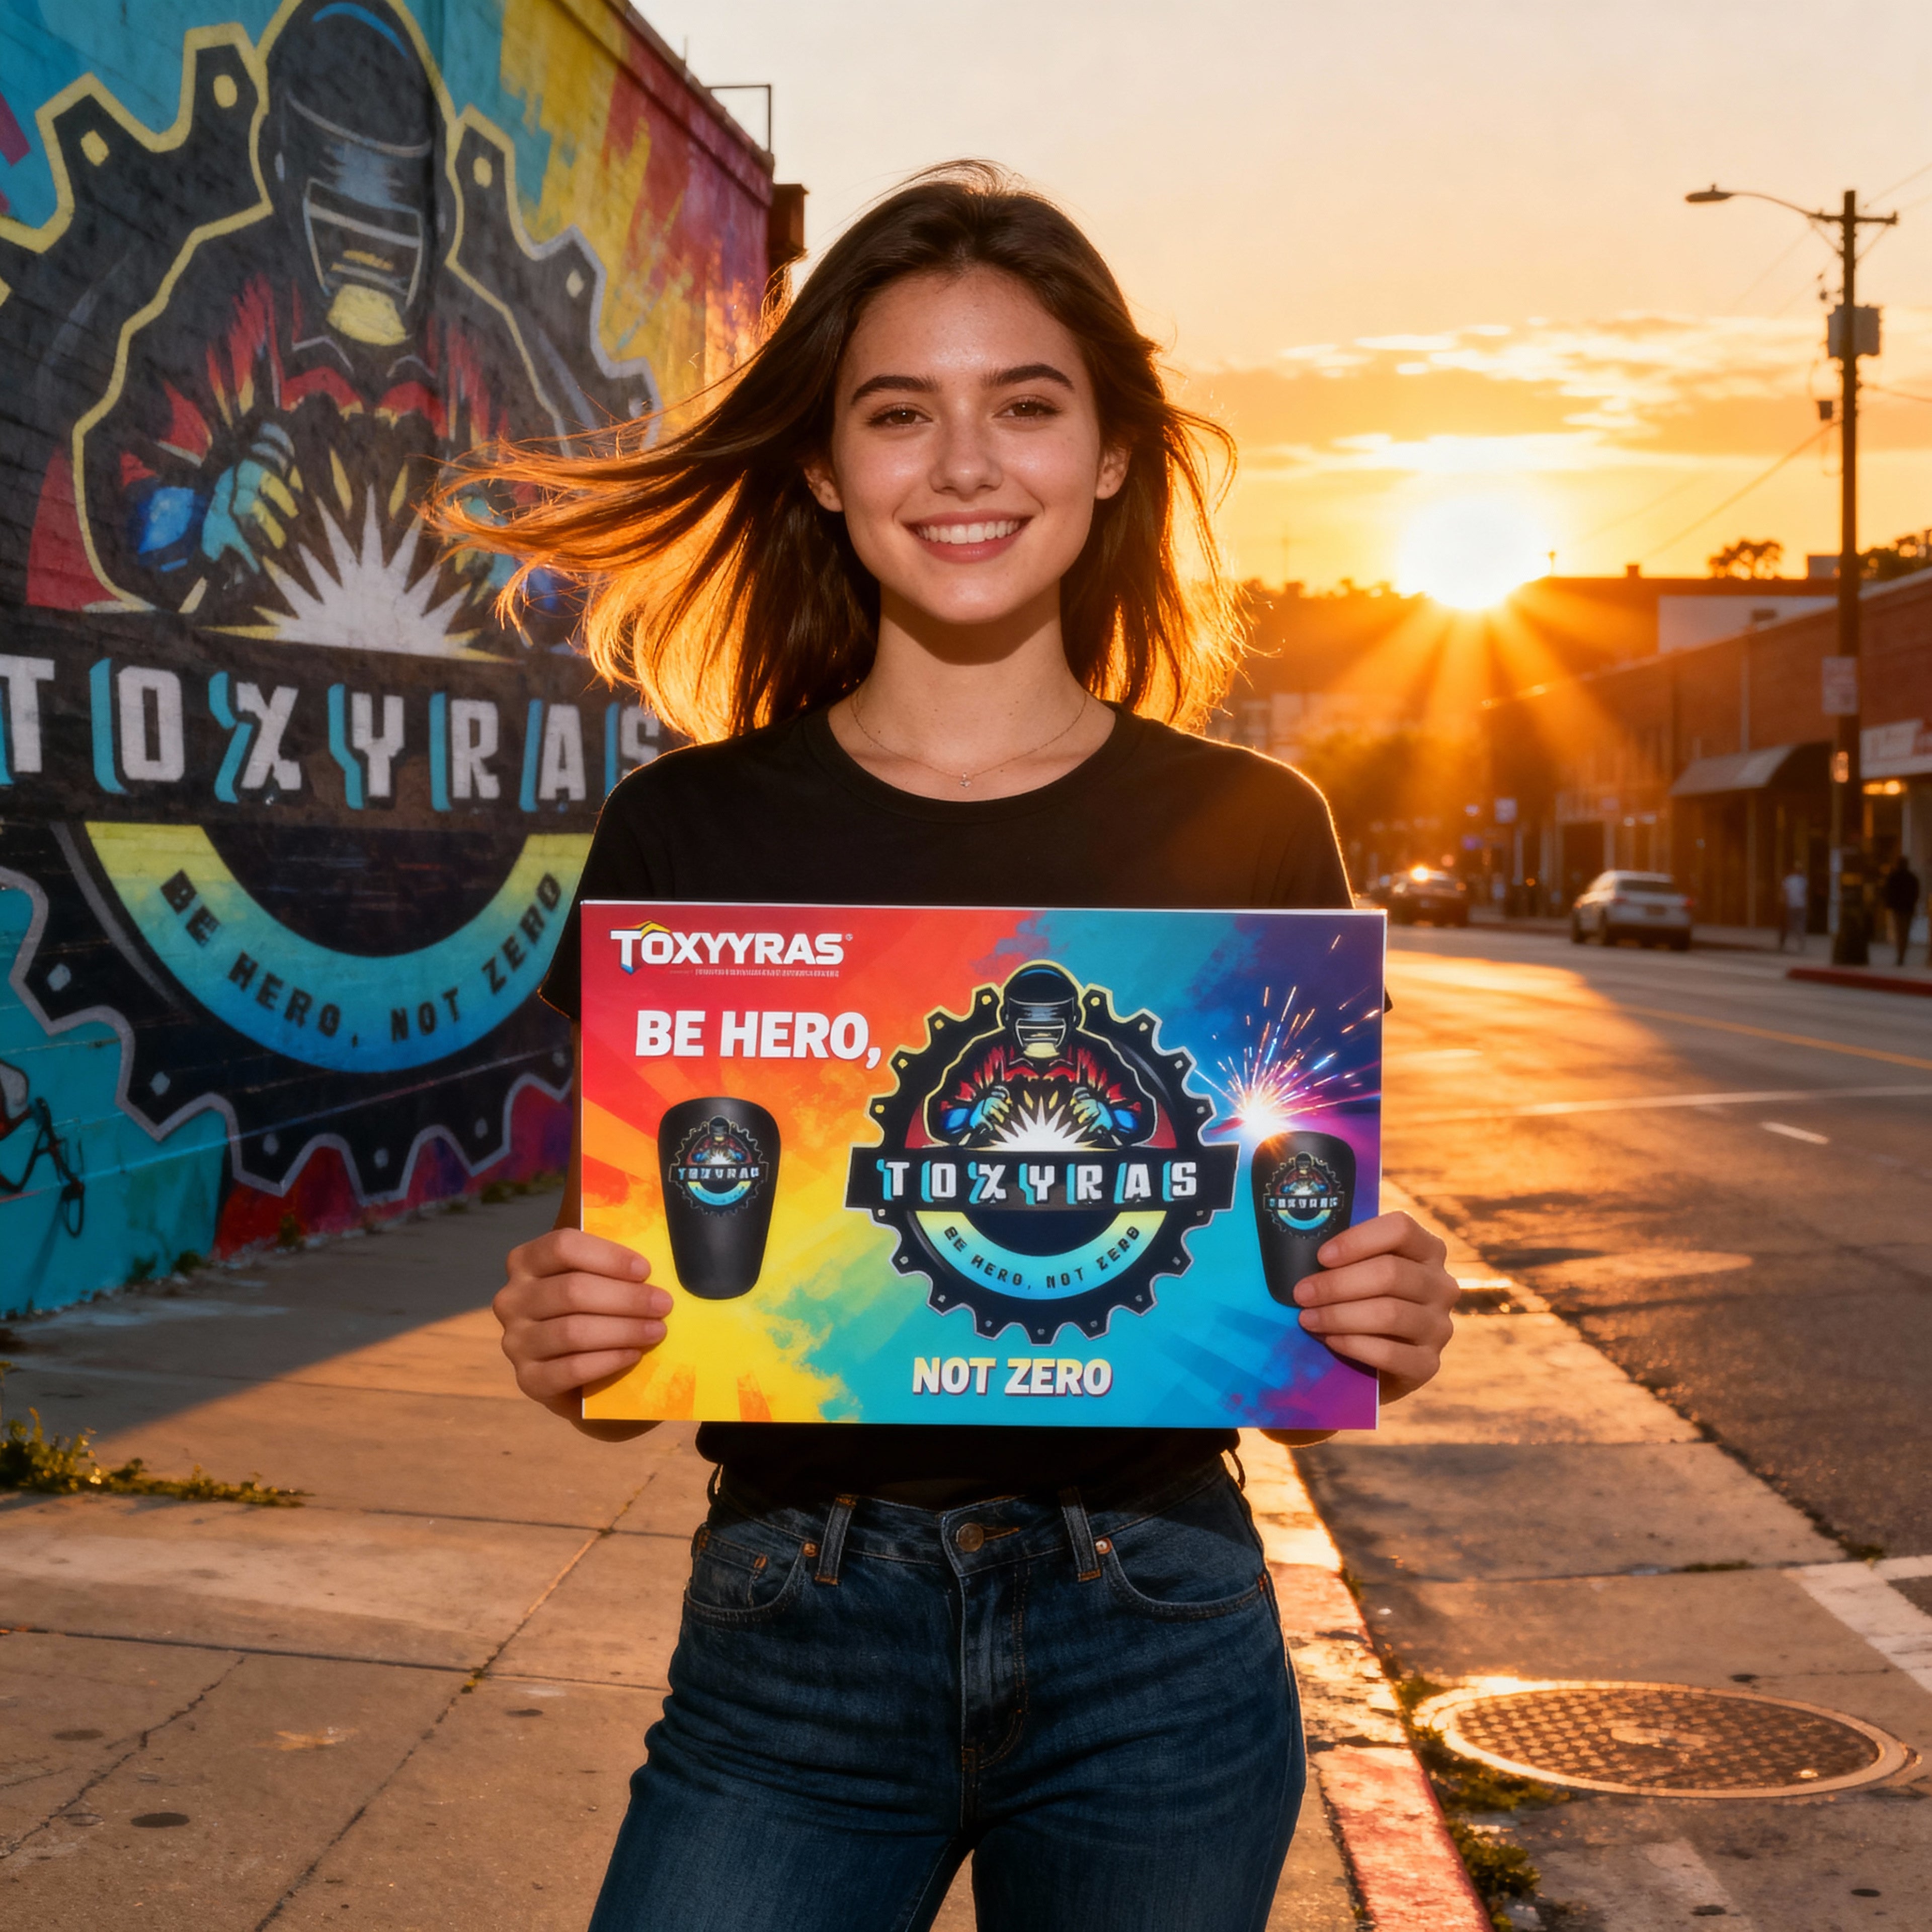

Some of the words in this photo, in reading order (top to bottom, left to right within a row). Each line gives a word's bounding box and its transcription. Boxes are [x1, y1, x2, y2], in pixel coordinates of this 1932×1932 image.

[160, 869, 220, 948] BE
[228, 950, 359, 1047] HERO,
[391, 987, 460, 1042] NOT
[481, 873, 561, 995] ZERO
[610, 930, 844, 974] TOXYYRAS
[635, 1010, 705, 1057] BE
[720, 1011, 881, 1070] HERO,
[876, 1159, 1197, 1204] TOXYRAS
[944, 1226, 968, 1252] BE
[971, 1254, 1030, 1290] HERO,
[1046, 1267, 1083, 1289] NOT
[1096, 1226, 1140, 1271] ZERO
[912, 1357, 997, 1396] NOT
[1004, 1358, 1113, 1397] ZERO
